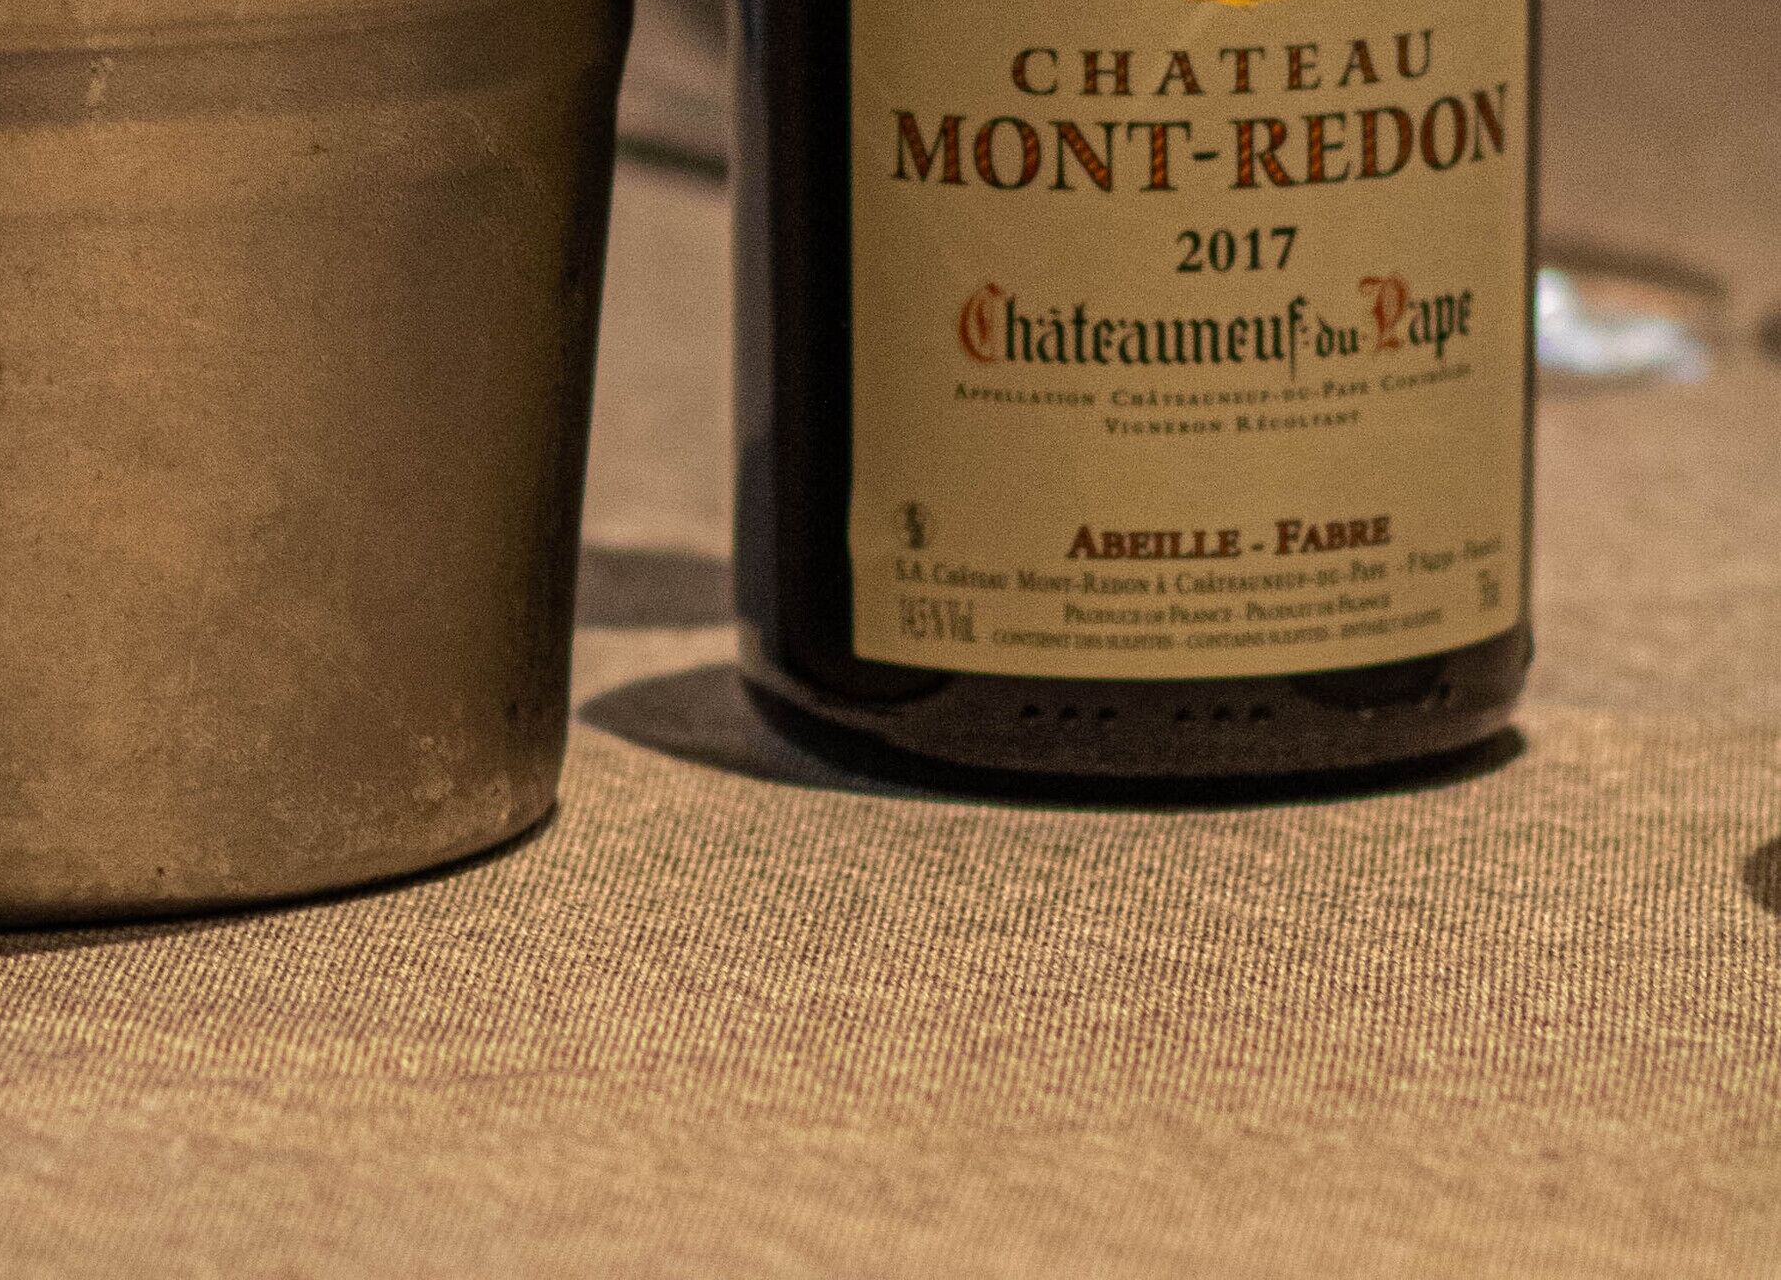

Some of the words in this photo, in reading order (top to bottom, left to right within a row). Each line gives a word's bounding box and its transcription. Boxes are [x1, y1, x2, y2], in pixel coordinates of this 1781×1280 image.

[1011, 29, 1434, 97] CHATEAU
[890, 82, 1510, 193] MONT-REDON
[1175, 226, 1299, 274] 2017
[1064, 522, 1243, 562] ABEILLE
[1274, 514, 1392, 557] FABRE
